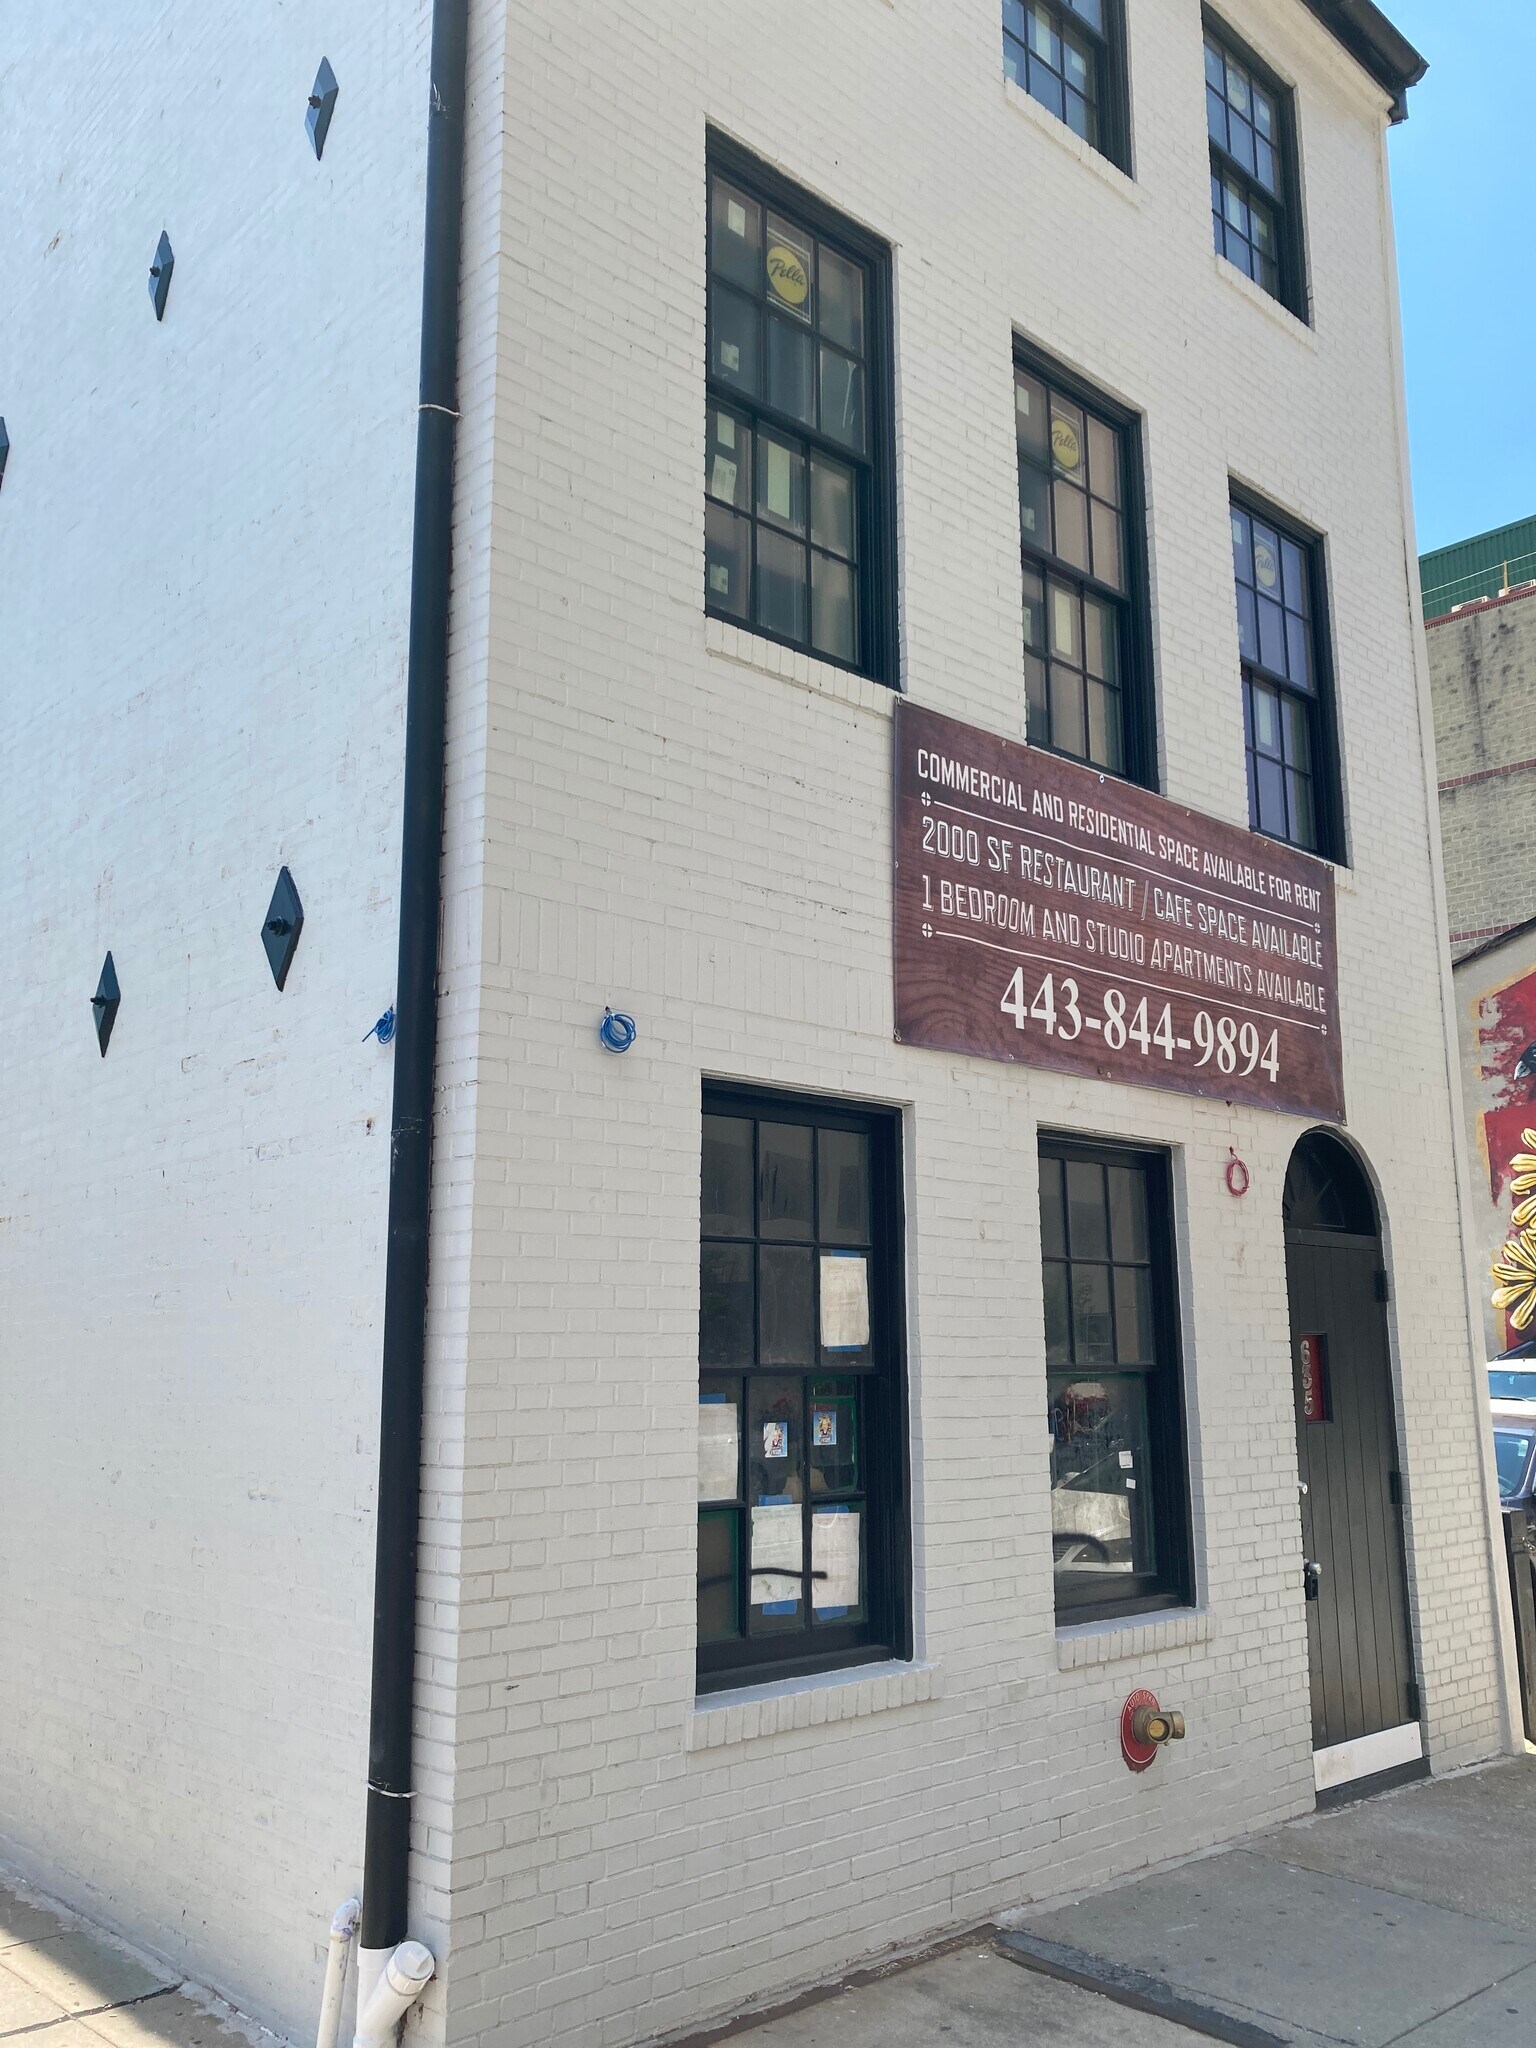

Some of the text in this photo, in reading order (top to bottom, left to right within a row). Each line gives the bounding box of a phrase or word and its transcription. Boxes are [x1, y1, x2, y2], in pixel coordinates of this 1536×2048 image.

[769, 257, 805, 286] Pella
[917, 748, 1321, 913] COMMERCIAL AND RESIDENTIAL SPACE AVAILABLE FOR RENT
[922, 815, 1323, 970] 2000 SF RESTAURANT / CAFE SPACE AVAILABLE
[922, 874, 1327, 1015] 1 BEDROOM AND STUDIO APARTMENTS AVAILABLE
[1000, 966, 1280, 1083] 443-844-9894
[1300, 1340, 1314, 1416] 635
[1127, 1693, 1140, 1713] AUTO
